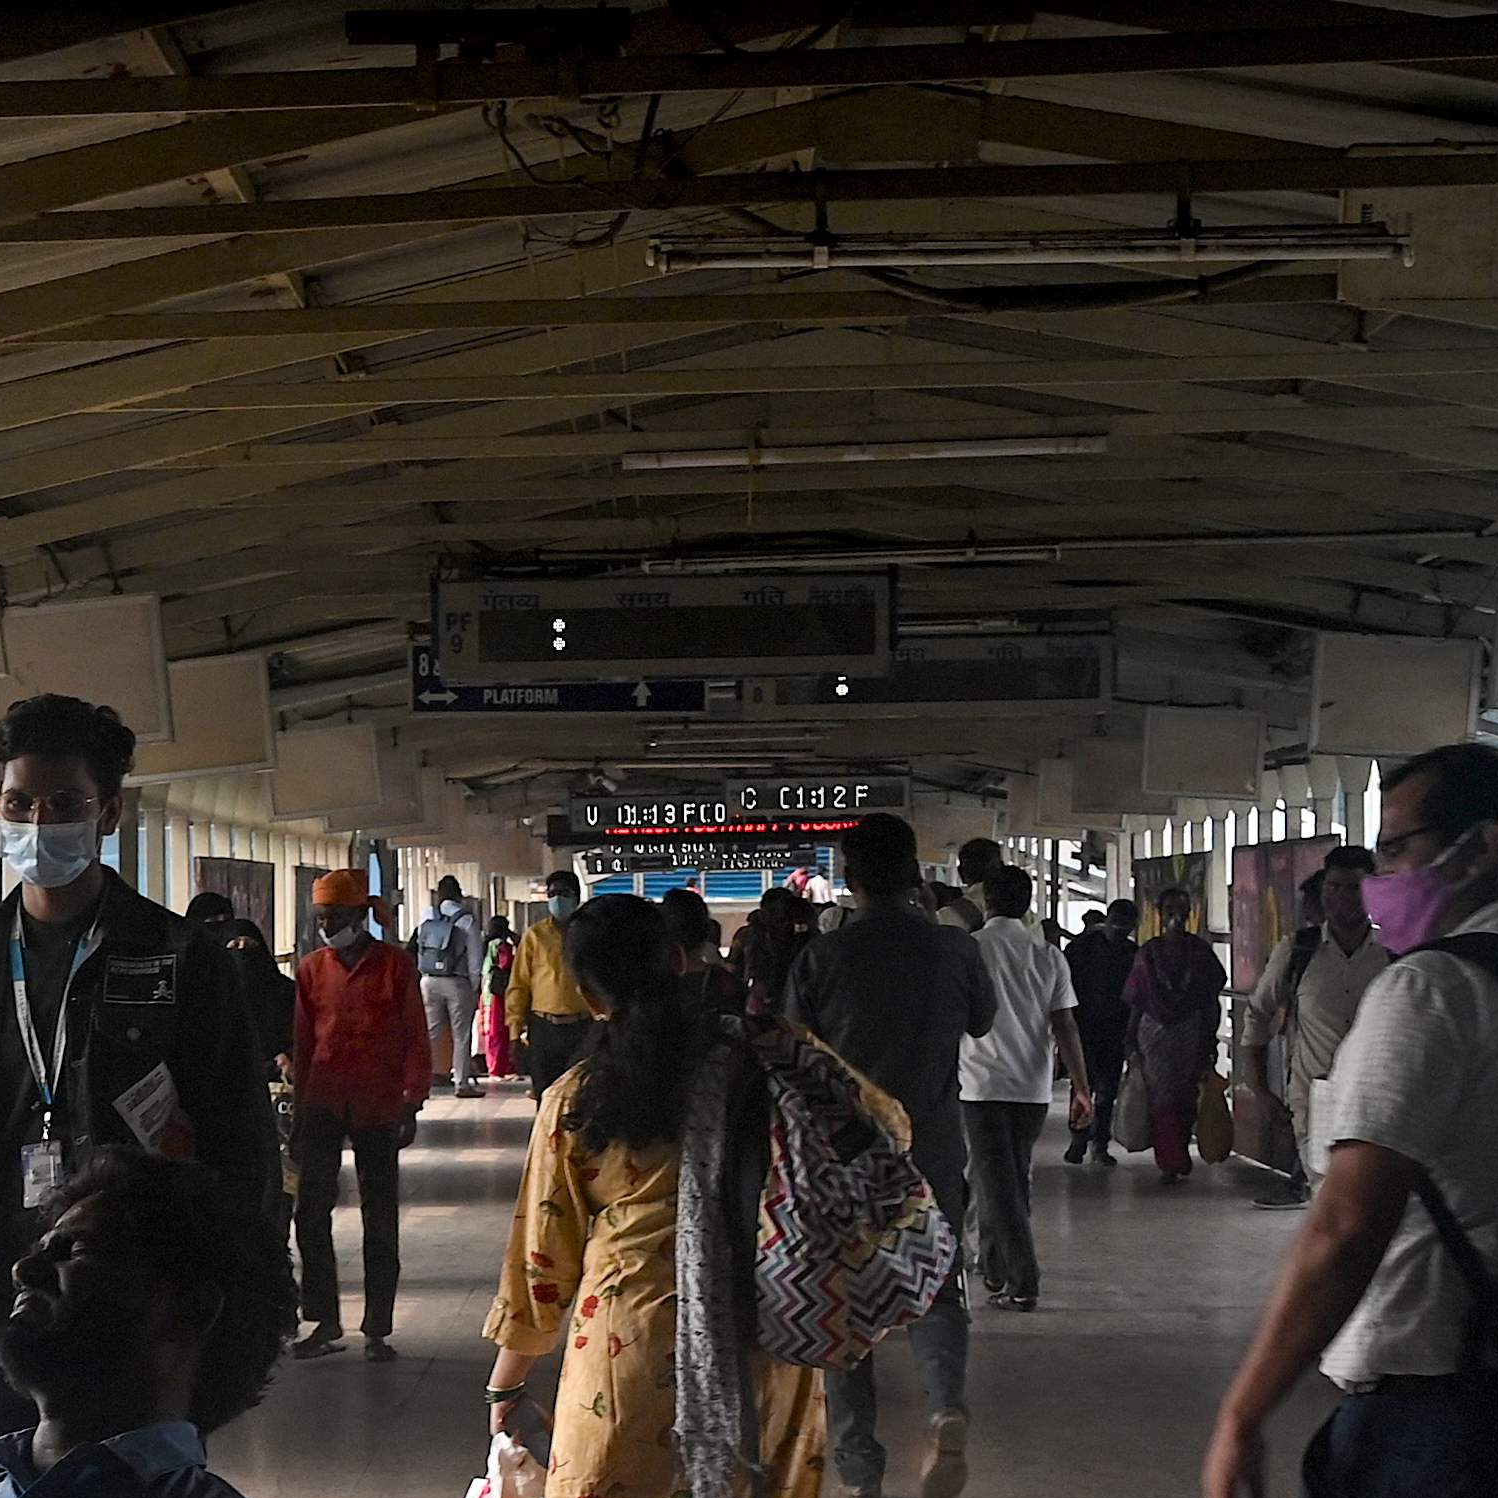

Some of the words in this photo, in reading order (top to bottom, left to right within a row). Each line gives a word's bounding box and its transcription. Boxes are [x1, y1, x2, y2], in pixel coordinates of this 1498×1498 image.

[615, 591, 671, 608] समय
[446, 612, 472, 632] PF
[452, 634, 463, 653] 9
[418, 653, 430, 677] 8
[483, 688, 559, 705] PLATFORM
